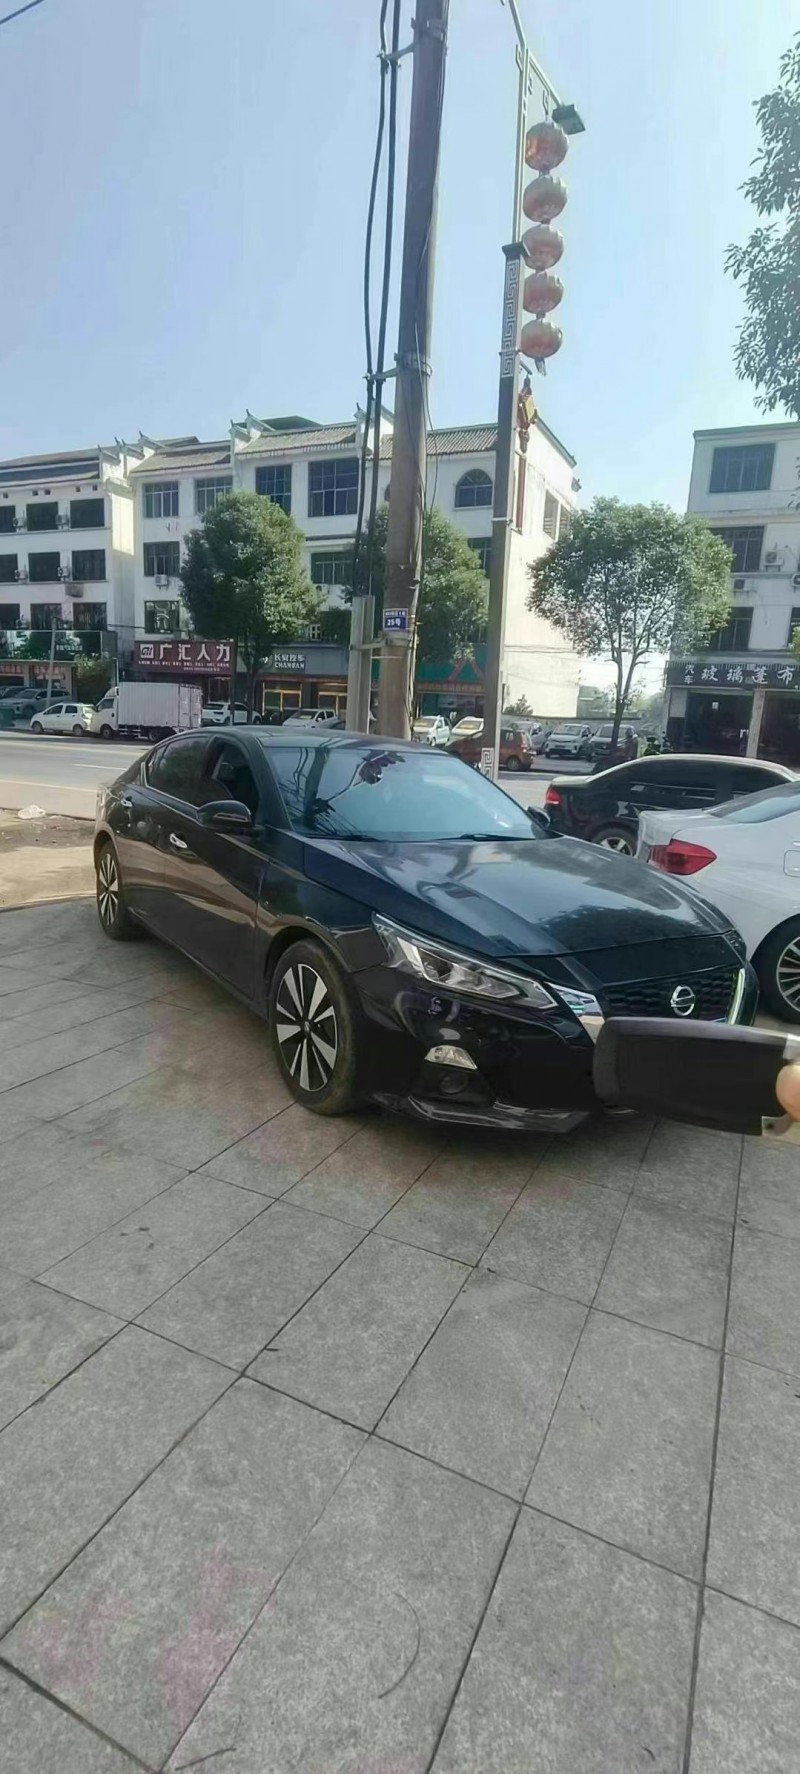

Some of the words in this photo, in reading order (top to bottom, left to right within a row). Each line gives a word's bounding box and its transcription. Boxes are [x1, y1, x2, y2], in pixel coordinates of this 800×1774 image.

[159, 643, 230, 661] 广汇人力
[684, 664, 695, 684] 汽车
